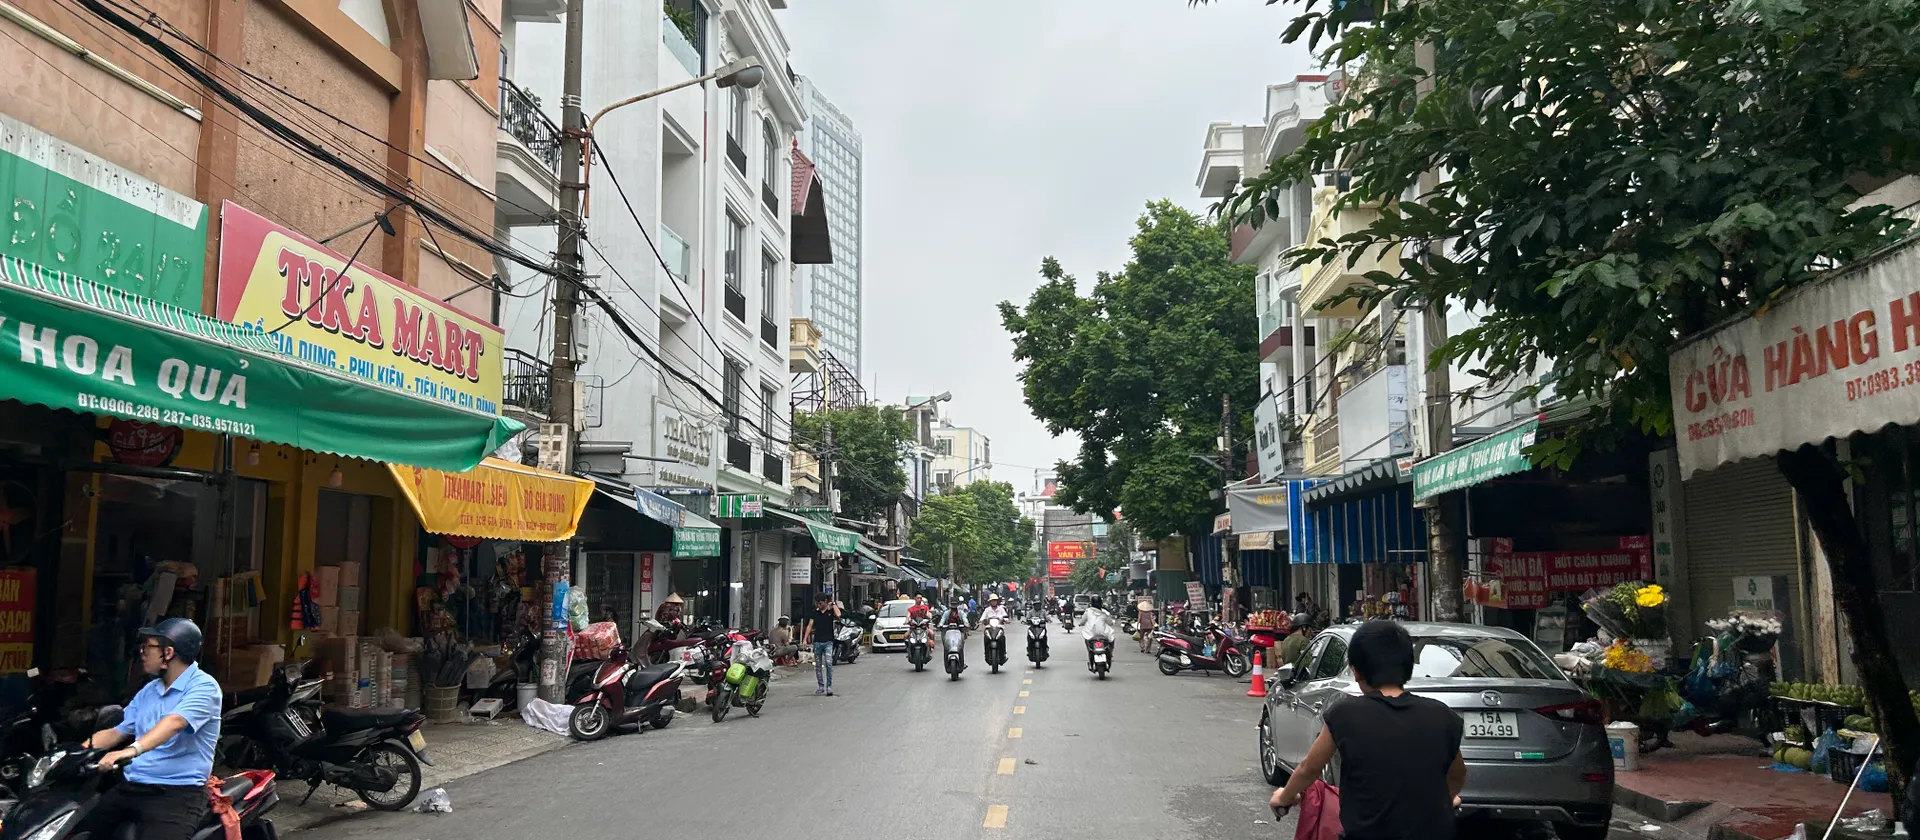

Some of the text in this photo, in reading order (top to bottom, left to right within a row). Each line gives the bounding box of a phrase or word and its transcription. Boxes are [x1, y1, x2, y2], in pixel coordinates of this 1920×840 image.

[278, 247, 484, 382] TIKA MART
[18, 322, 248, 410] HOA QUẢ
[1685, 345, 1752, 413] CỬA
[1763, 310, 1880, 393] HÀNG
[1503, 554, 1544, 577] BÁN ĐÁ
[1470, 724, 1513, 736] 334.99
[1480, 711, 1502, 723] 15A
